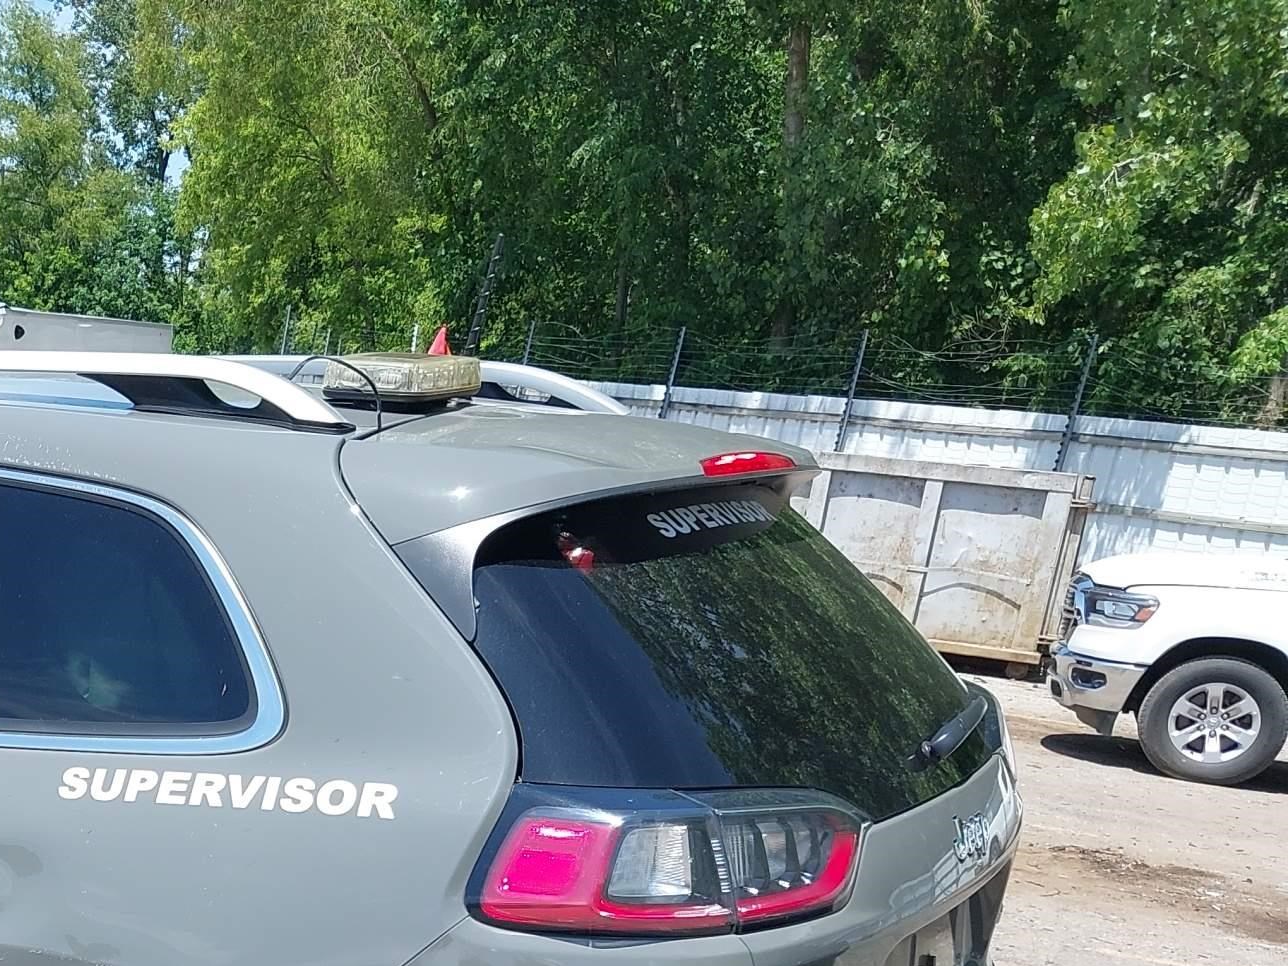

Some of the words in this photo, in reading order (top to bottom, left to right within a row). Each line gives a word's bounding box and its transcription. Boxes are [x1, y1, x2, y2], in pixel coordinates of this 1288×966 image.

[646, 500, 777, 538] SUPERVISOR
[58, 767, 398, 819] SUPERVISOR
[952, 812, 991, 862] Jeep
